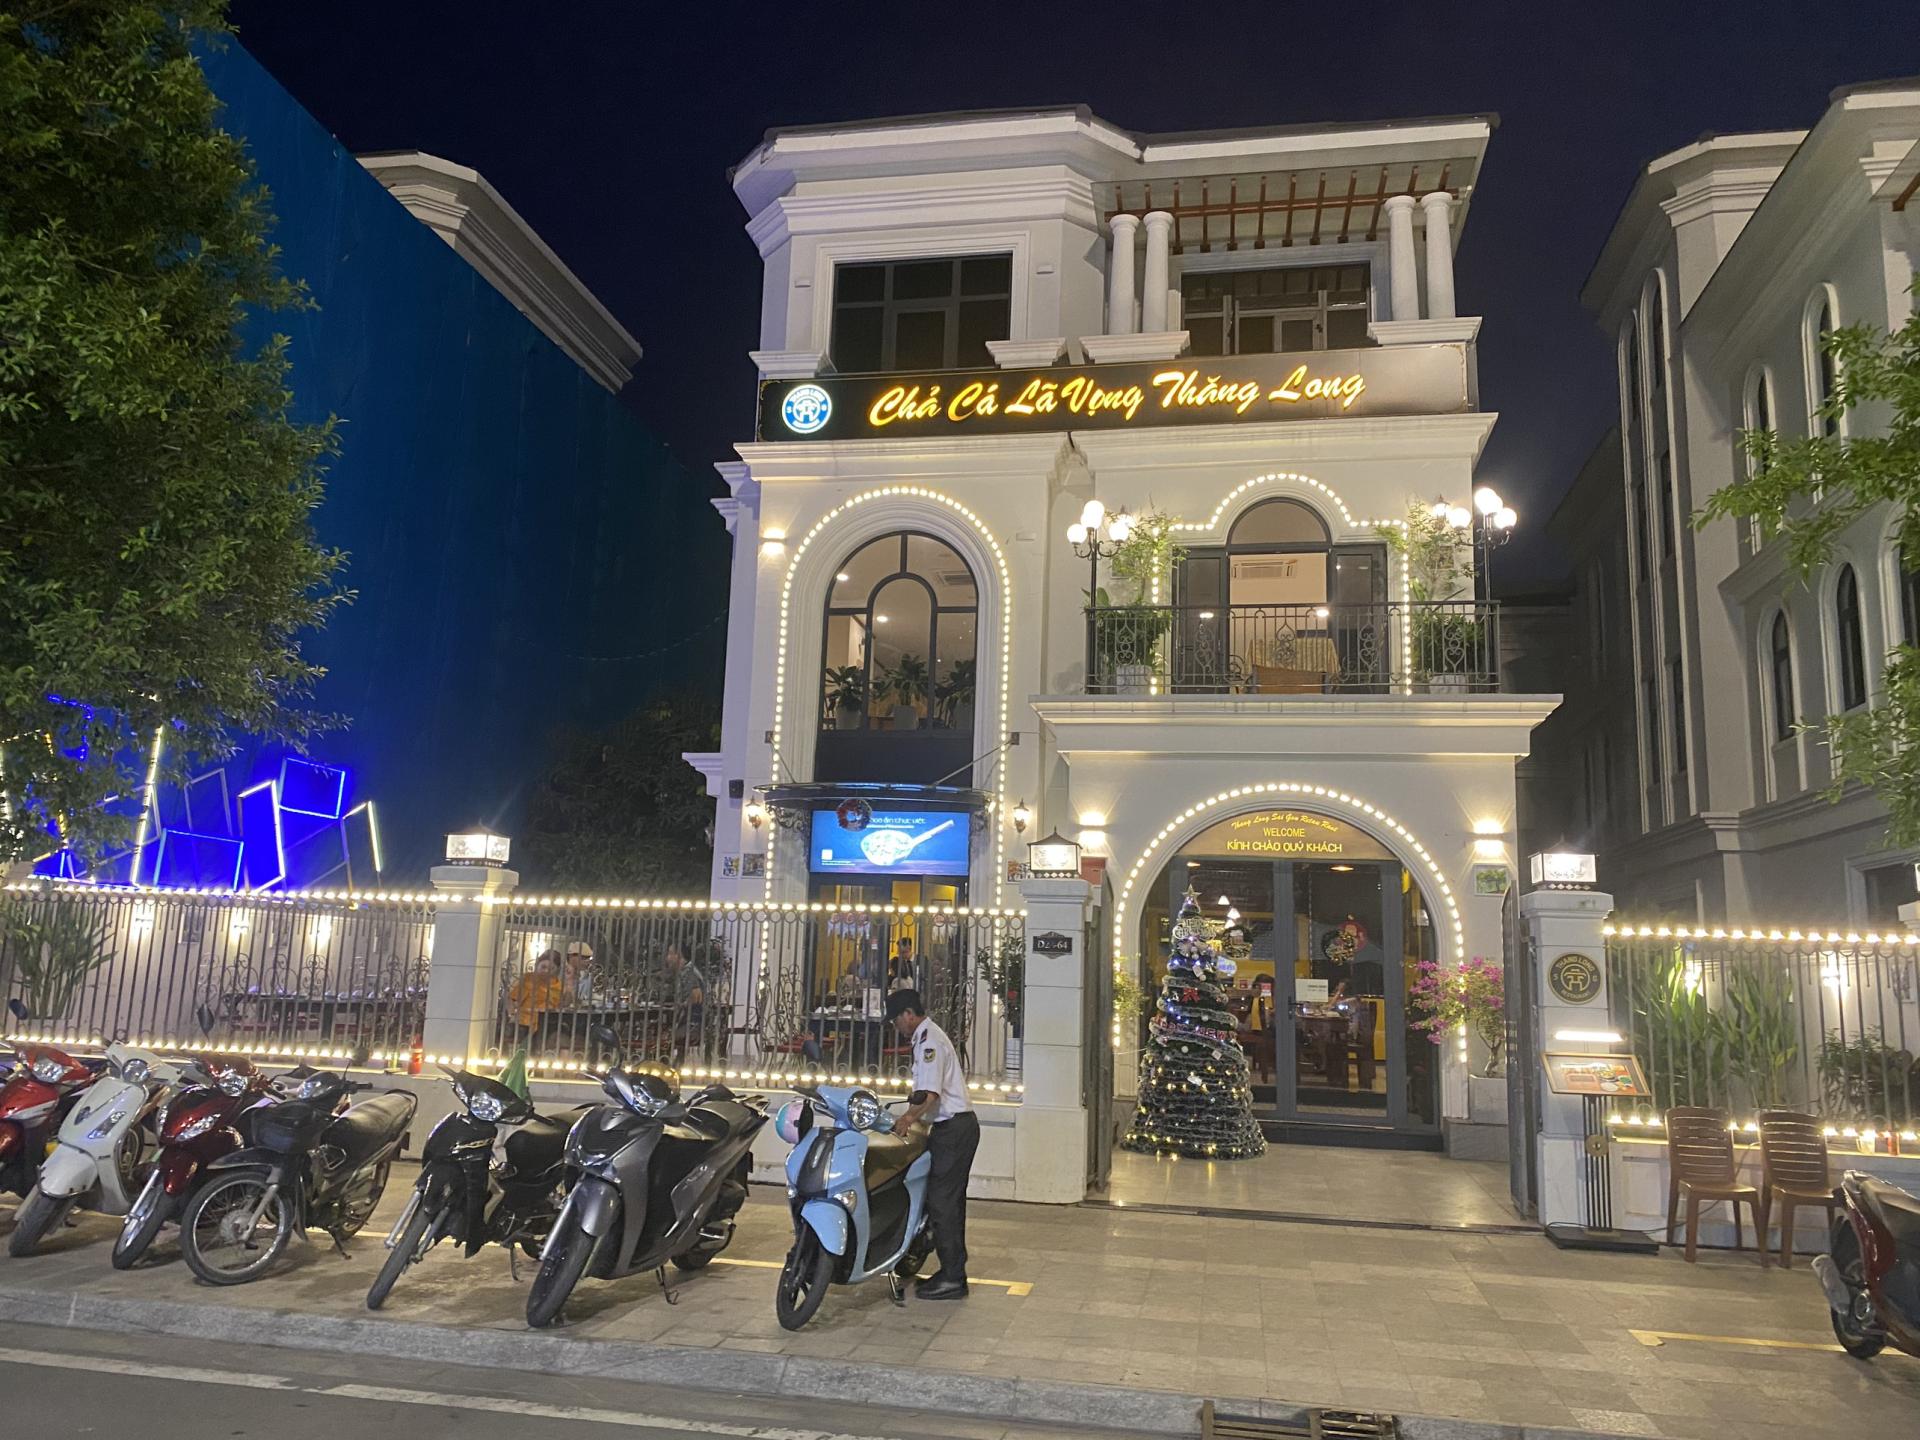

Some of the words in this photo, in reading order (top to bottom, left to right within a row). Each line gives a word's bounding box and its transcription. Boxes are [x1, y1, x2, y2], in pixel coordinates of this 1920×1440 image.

[869, 384, 942, 427] Chả
[947, 382, 999, 422] Cá
[1004, 379, 1058, 415] Lã
[1061, 376, 1144, 421] Vọng
[1152, 369, 1260, 415] Thăng
[1268, 364, 1366, 410] Long
[1263, 827, 1305, 837] WELCOME
[1252, 840, 1281, 851] CHÀO
[1306, 841, 1342, 852] KHÁCH
